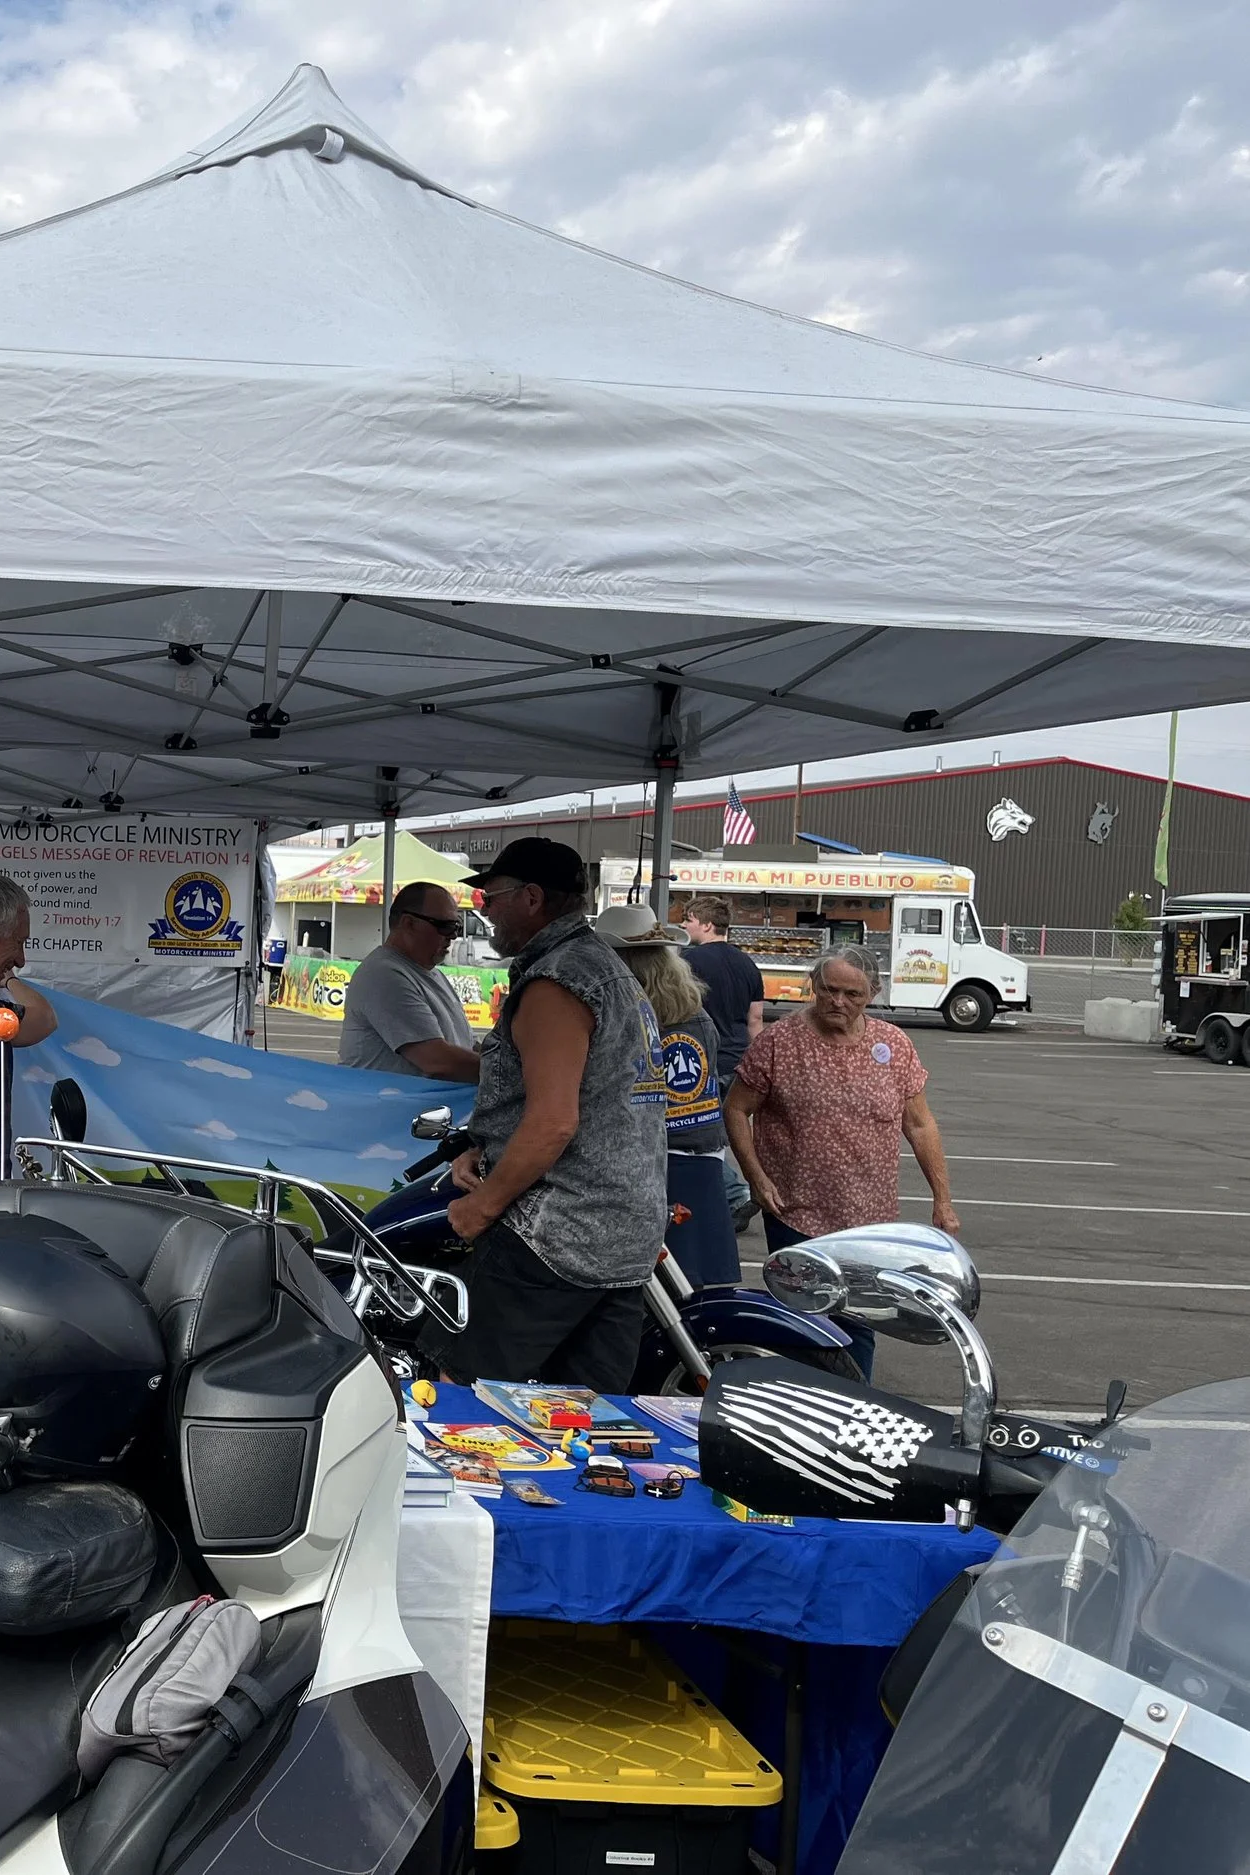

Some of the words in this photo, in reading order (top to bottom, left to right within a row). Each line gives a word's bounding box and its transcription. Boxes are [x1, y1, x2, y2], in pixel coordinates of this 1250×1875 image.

[143, 827, 242, 847] MINISTRY
[42, 848, 111, 861] MESSAGE
[115, 849, 135, 862] OF
[139, 850, 229, 865] REVELATION
[235, 853, 250, 865] 14
[13, 870, 31, 879] not
[34, 870, 62, 881] given
[65, 871, 76, 879] us
[79, 869, 96, 880] the
[671, 869, 759, 885] QUERIA
[770, 873, 794, 885] MI
[804, 873, 915, 889] PUEBLITO
[27, 883, 39, 893] of
[40, 885, 75, 895] power,
[77, 885, 98, 895] and
[63, 899, 93, 909] mind.
[43, 914, 50, 924] 2
[52, 913, 101, 928] Timothy
[105, 916, 121, 927] 1:7
[25, 938, 40, 950] ER
[43, 938, 103, 952] CHAPTER
[155, 948, 201, 956] MOTORCYCLE
[312, 977, 350, 1006] Garc
[677, 1033, 704, 1057] Keepers
[667, 1091, 691, 1103] th-day
[666, 1117, 696, 1129] ORCYCLE
[697, 1111, 720, 1123] MINISTRY
[1041, 1446, 1085, 1464] ATIVE
